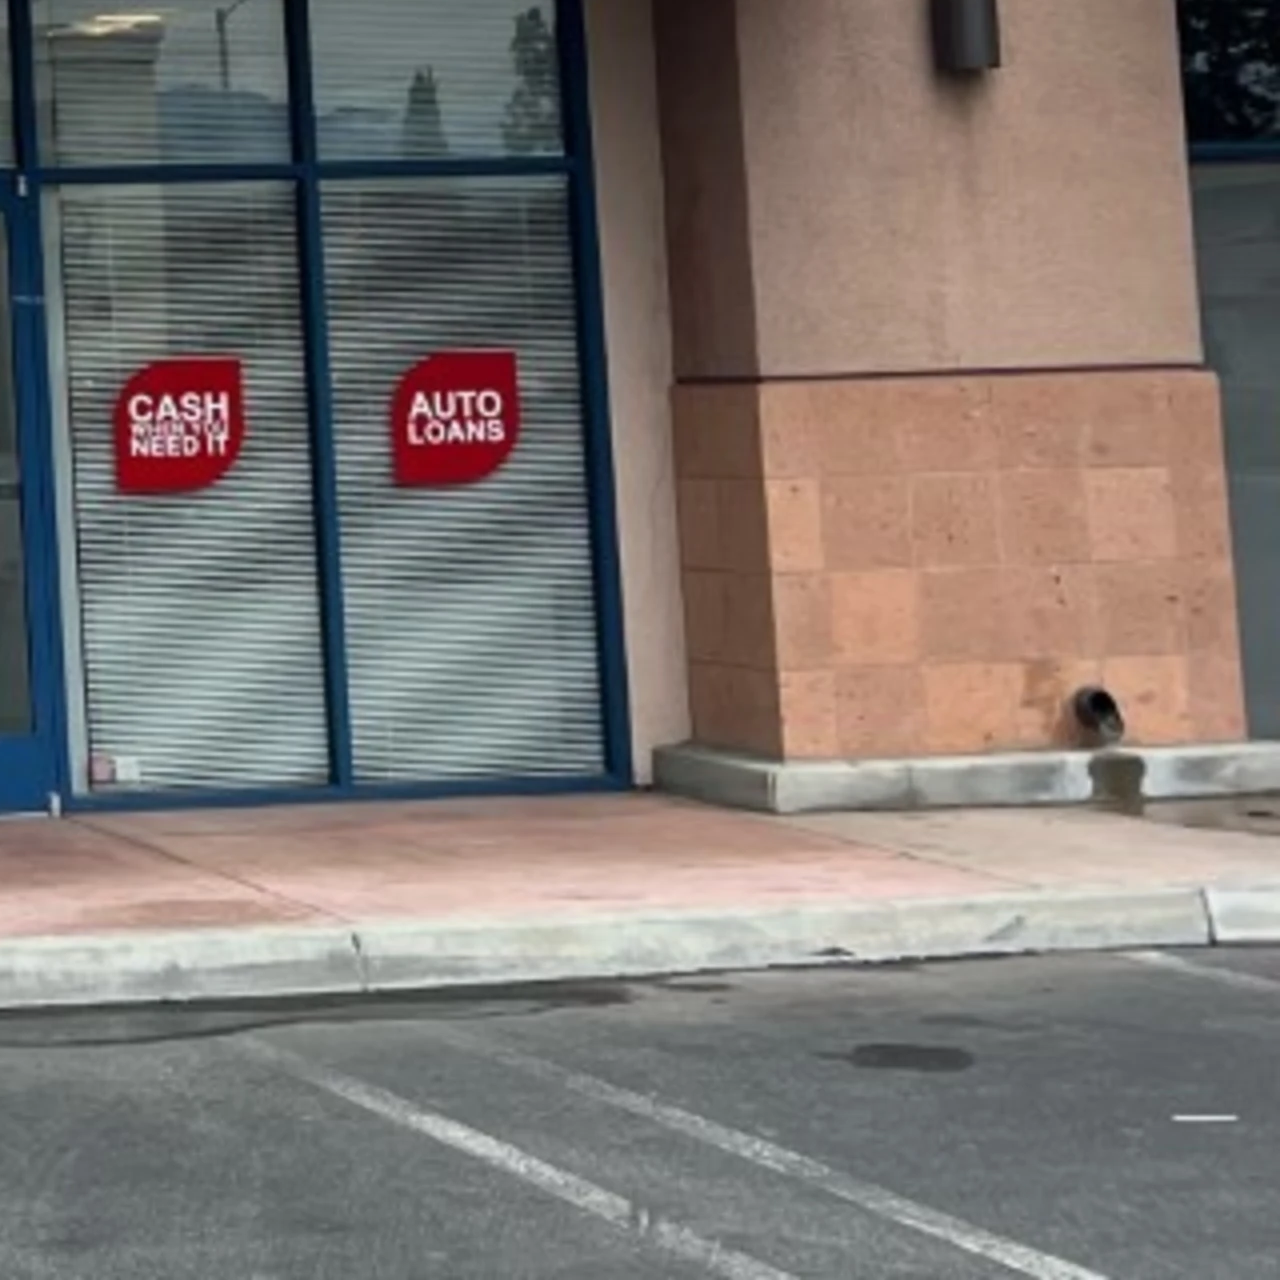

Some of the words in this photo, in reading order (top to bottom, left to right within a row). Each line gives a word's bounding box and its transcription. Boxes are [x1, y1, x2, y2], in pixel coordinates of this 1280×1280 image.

[128, 391, 230, 422] CASH
[409, 390, 502, 419] AUTO
[407, 418, 506, 445] LOANS
[131, 435, 201, 458] NEED
[206, 434, 229, 456] IT
